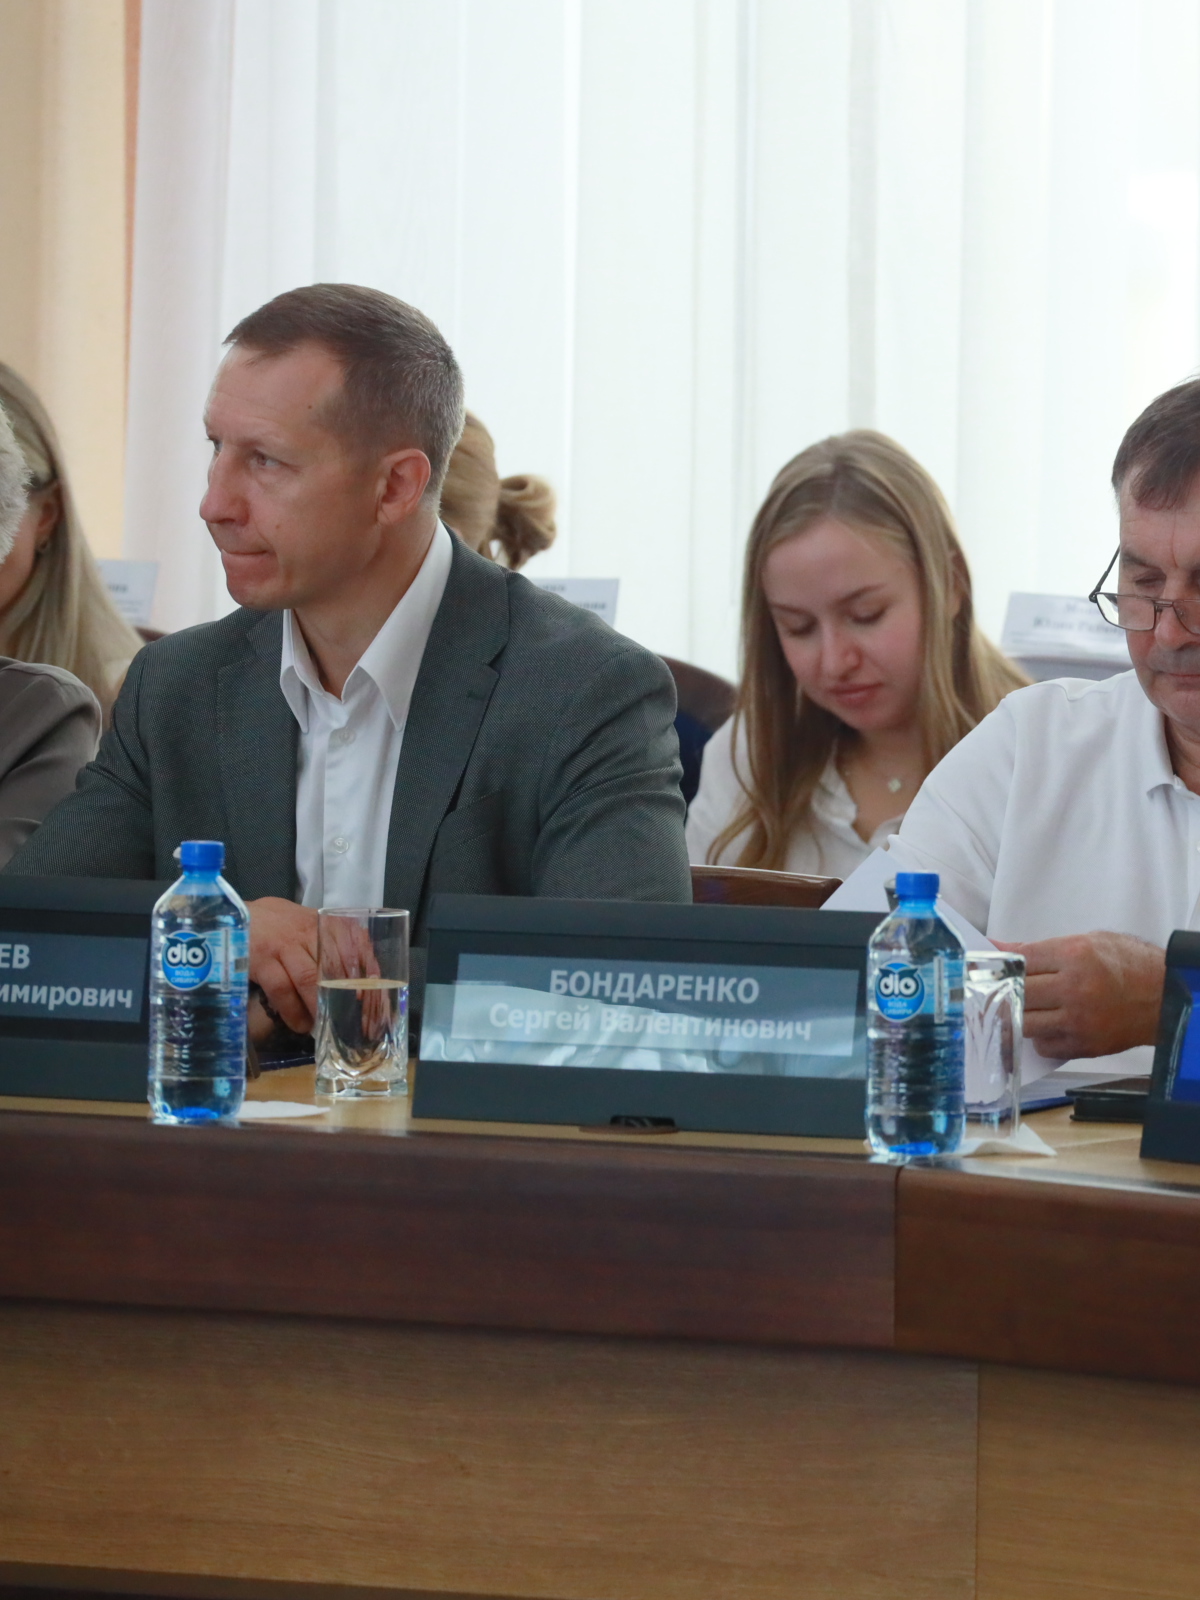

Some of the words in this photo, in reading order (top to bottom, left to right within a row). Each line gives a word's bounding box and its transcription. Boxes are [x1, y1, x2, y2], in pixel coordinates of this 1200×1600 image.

[167, 943, 204, 964] dio
[549, 970, 760, 1004] БОНДАРЕНКО
[880, 973, 917, 995] dio
[489, 1003, 591, 1034] Сергей
[600, 1007, 812, 1041] Валентинович
